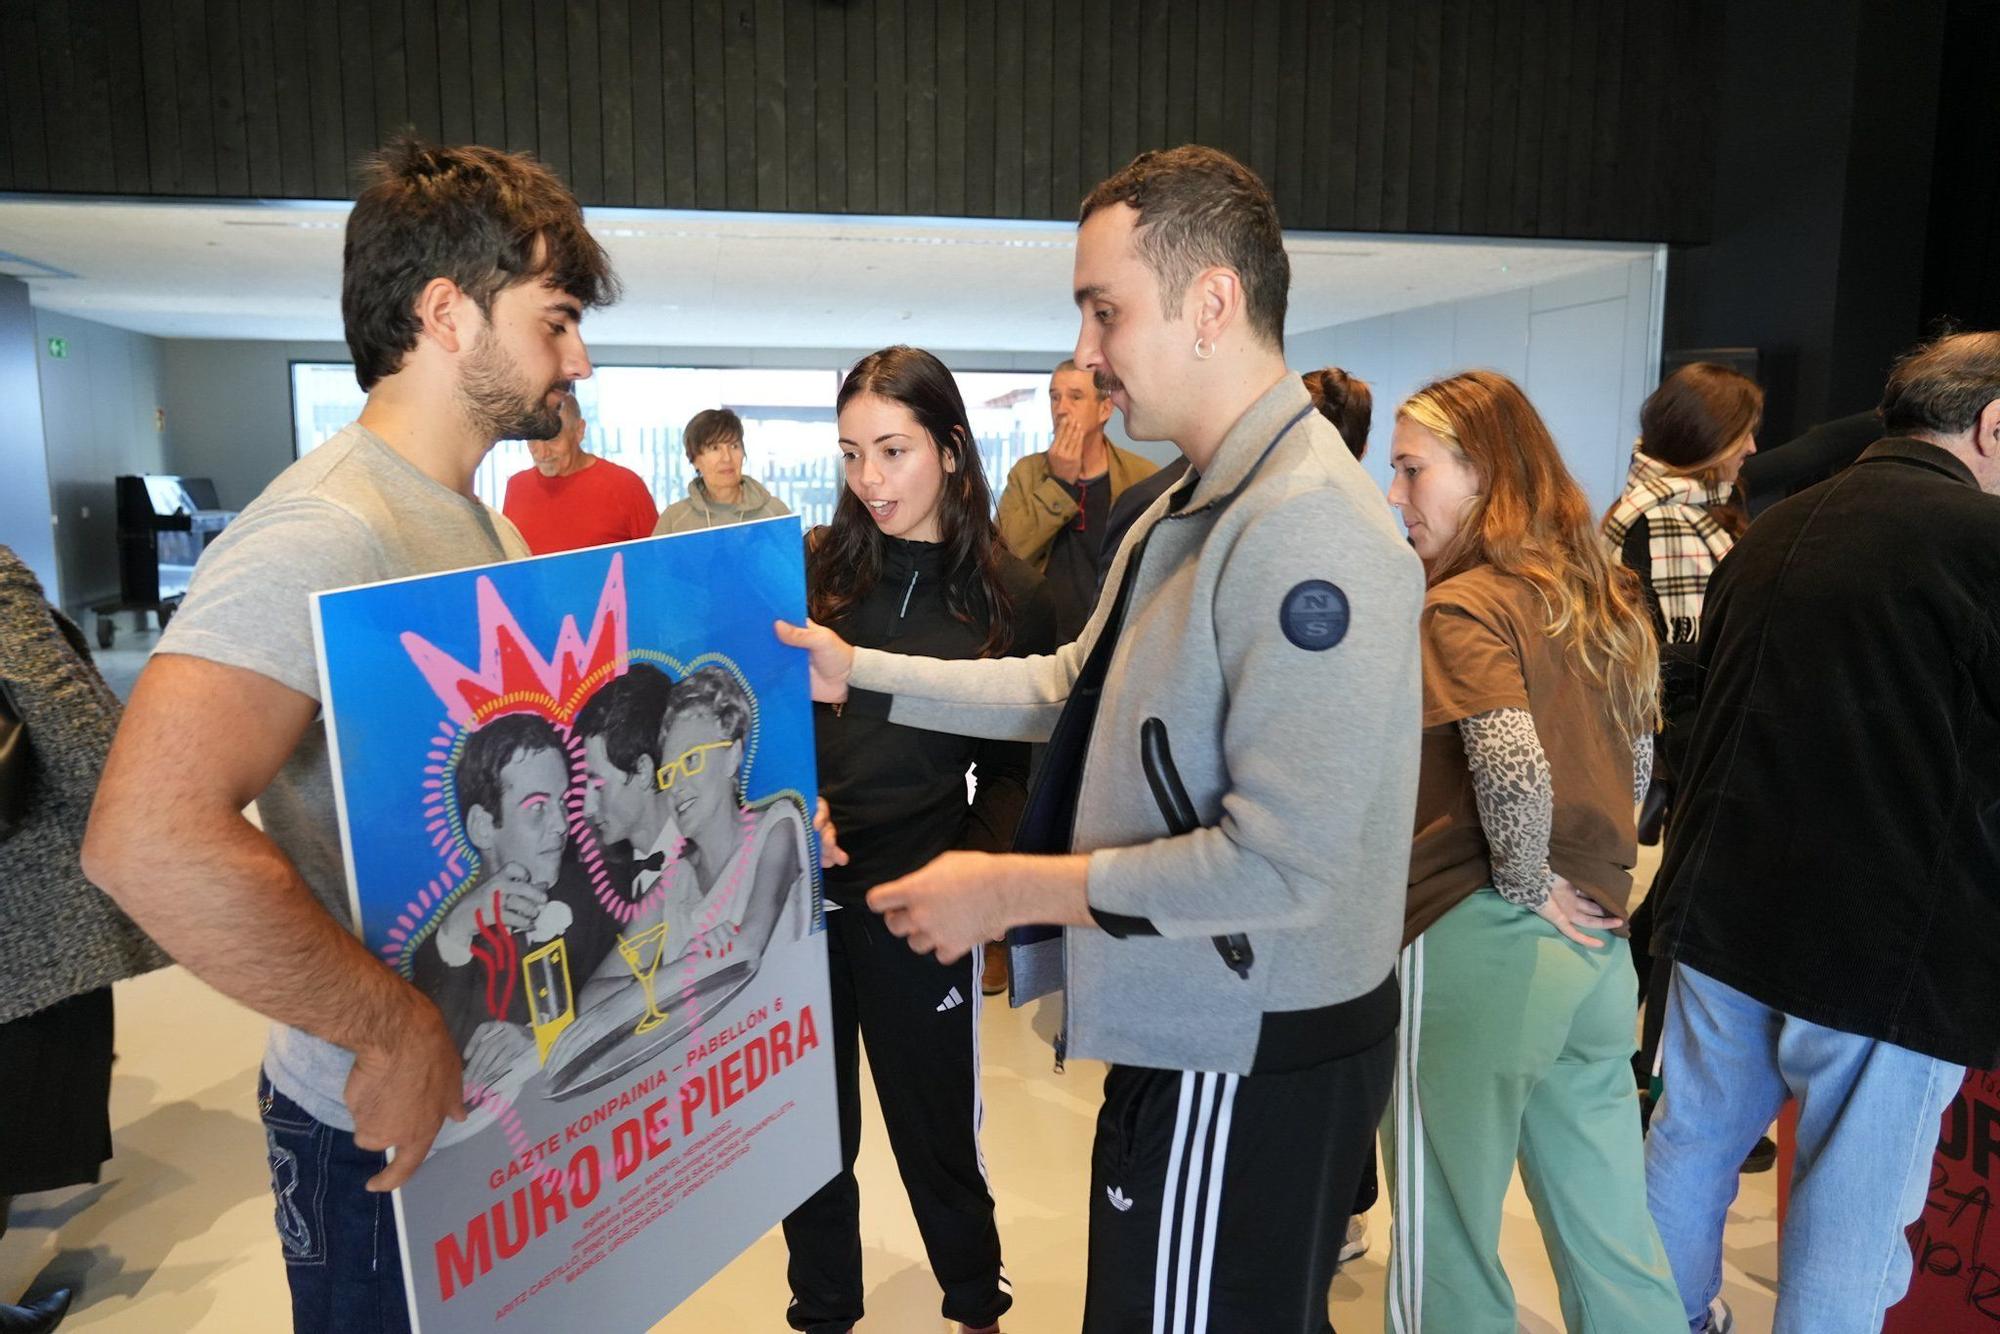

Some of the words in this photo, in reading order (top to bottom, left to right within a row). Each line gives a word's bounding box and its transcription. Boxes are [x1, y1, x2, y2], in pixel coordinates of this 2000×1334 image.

[1303, 594, 1328, 609] N
[1305, 621, 1329, 637] S
[489, 1133, 561, 1189] GAZTE
[565, 1070, 668, 1144] KONPAINIA
[686, 1009, 768, 1068] PABELLÓN
[774, 997, 784, 1012] 6
[434, 1144, 601, 1302] MURO
[611, 1096, 673, 1183] DE
[680, 1004, 820, 1138] PIEDRA
